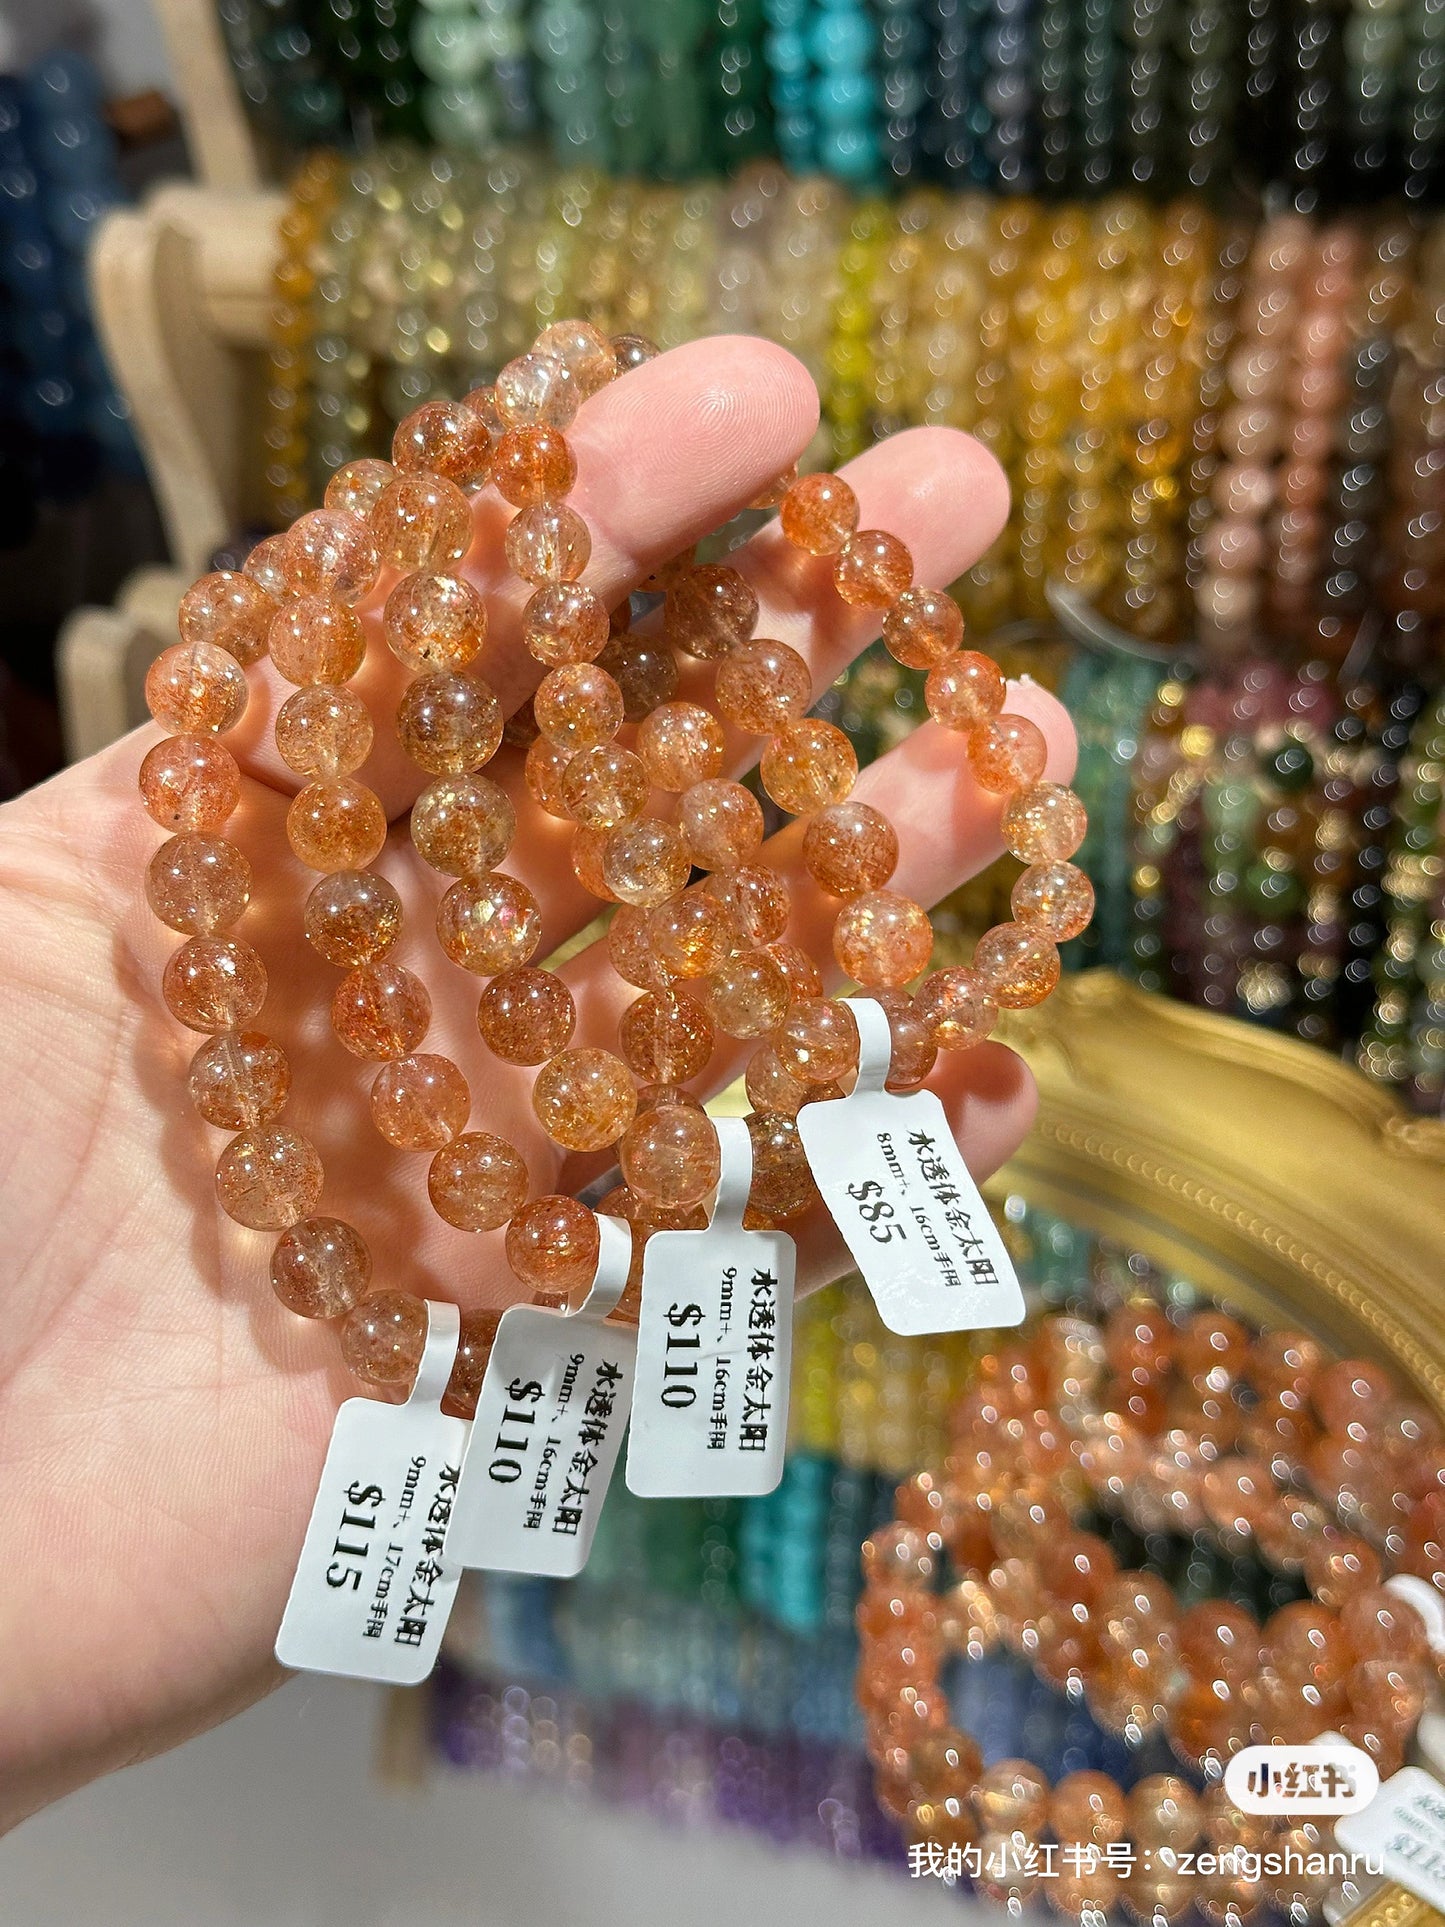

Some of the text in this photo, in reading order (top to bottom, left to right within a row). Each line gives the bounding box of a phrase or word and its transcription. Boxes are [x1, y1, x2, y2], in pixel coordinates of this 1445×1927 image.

[846, 1180, 907, 1244] $85
[906, 1128, 1000, 1286] 水透体金太阳
[661, 1302, 706, 1409] $110
[738, 1266, 779, 1452] 水透体金太阳
[489, 1376, 546, 1484] $110
[552, 1360, 624, 1536] 水透体金太阳
[326, 1480, 386, 1592] $115
